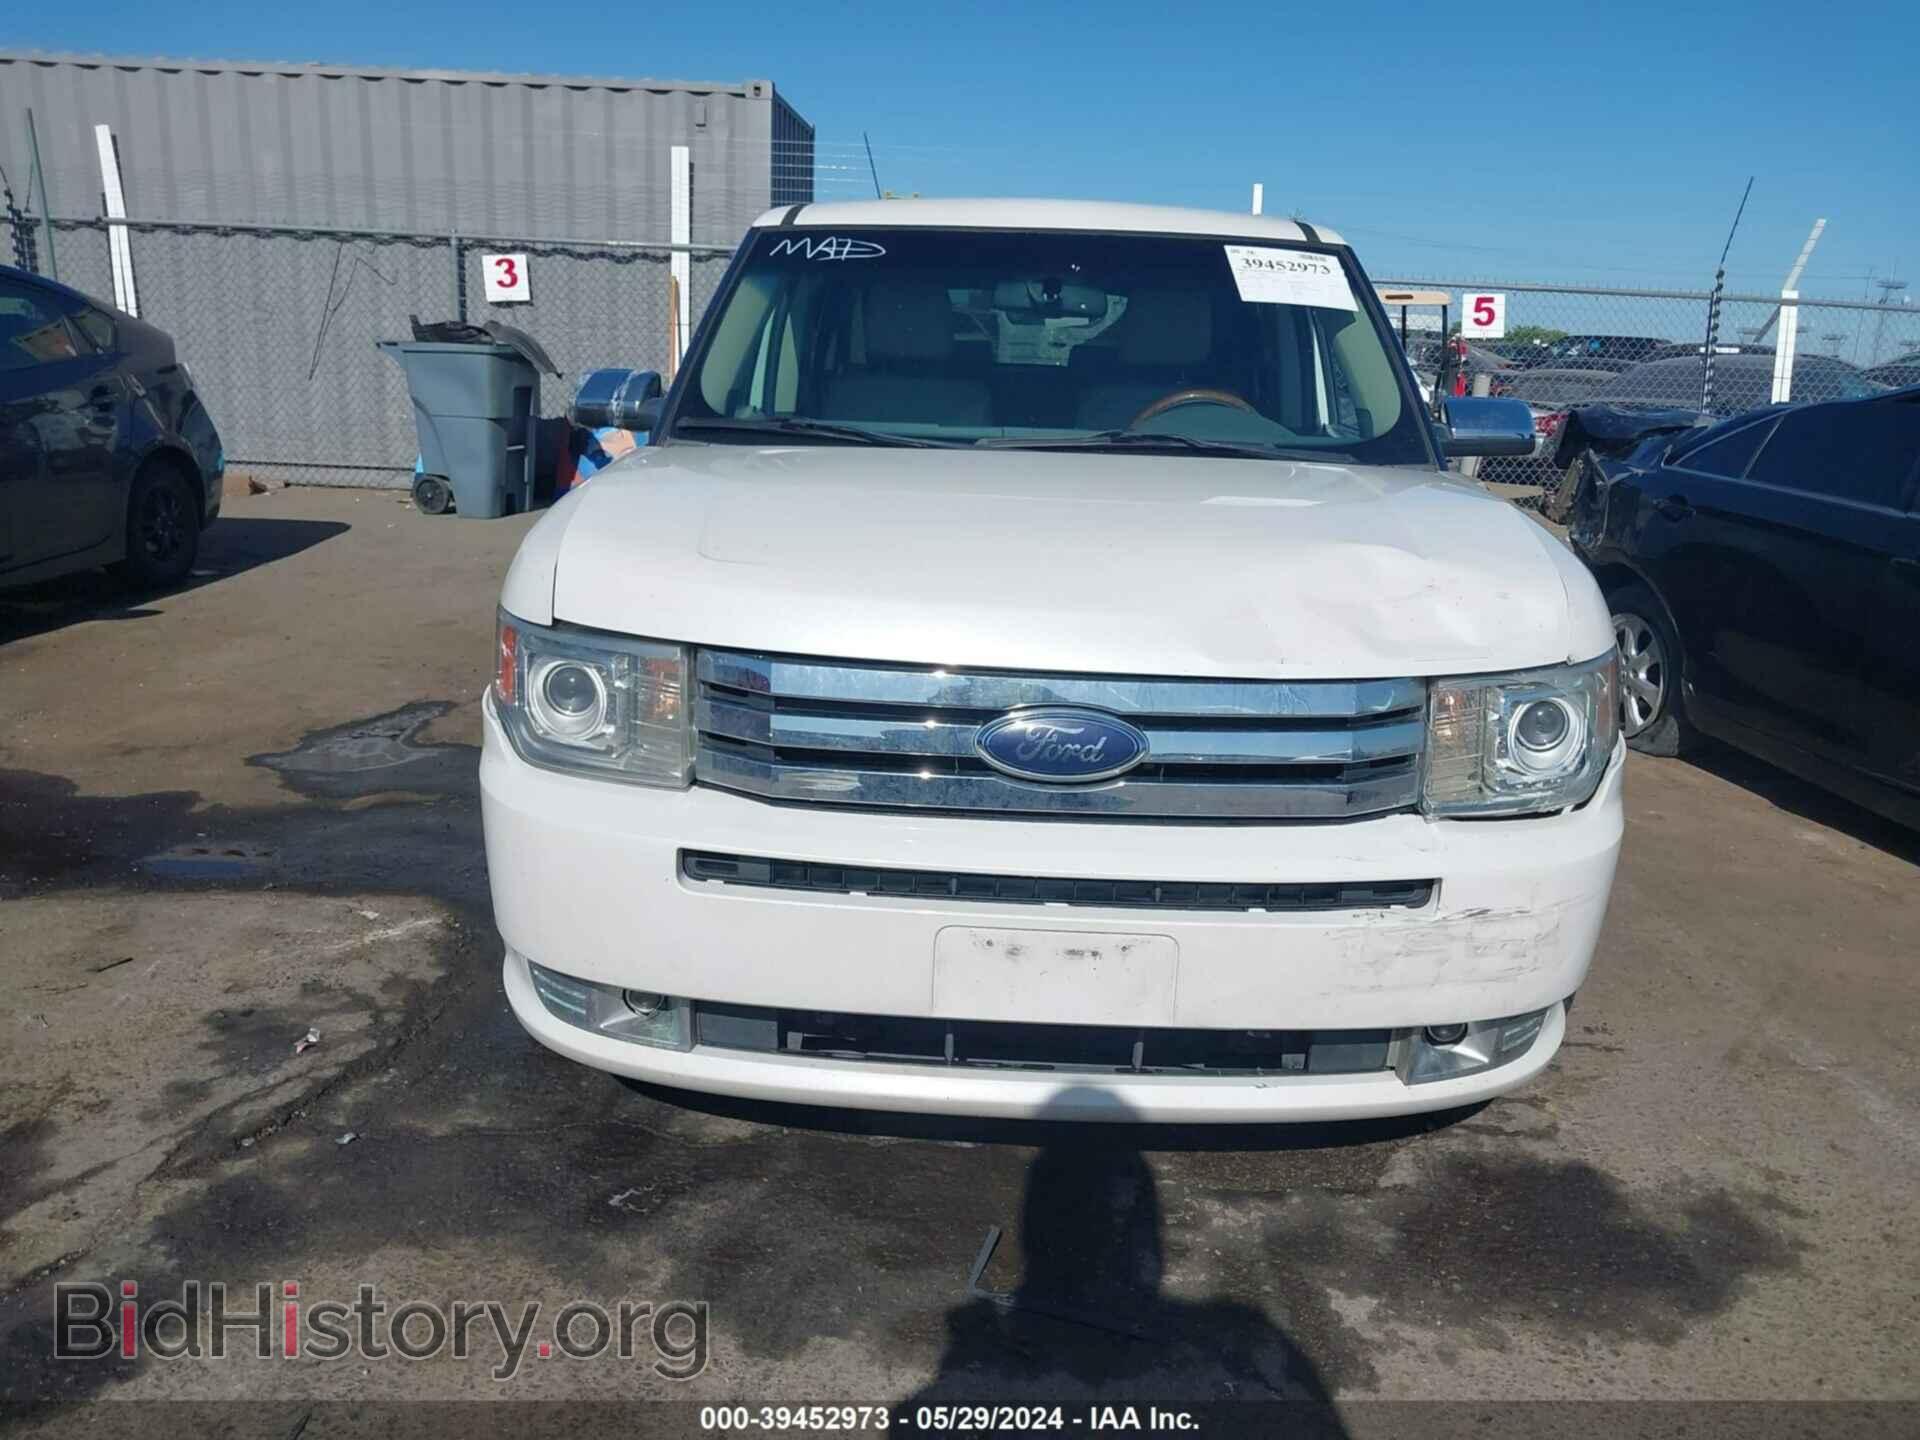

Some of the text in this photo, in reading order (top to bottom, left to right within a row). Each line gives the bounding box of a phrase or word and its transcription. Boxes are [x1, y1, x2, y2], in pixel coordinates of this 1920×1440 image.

[495, 258, 518, 288] 3
[1241, 258, 1331, 275] 39452973
[1473, 296, 1496, 326] 5
[1016, 722, 1107, 763] Ford
